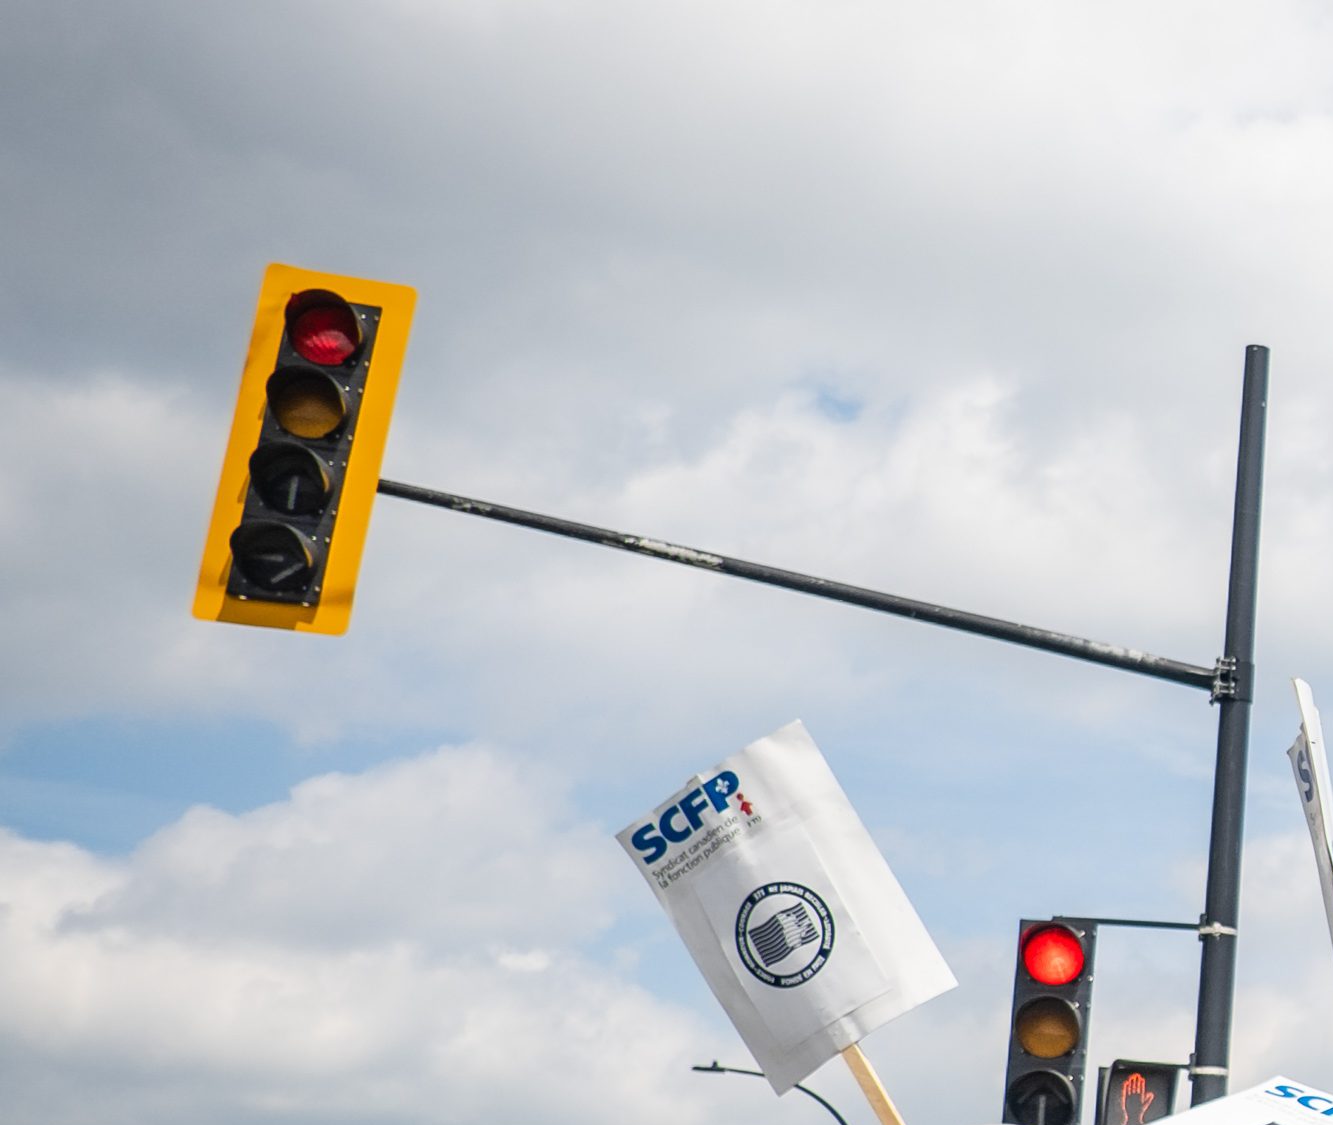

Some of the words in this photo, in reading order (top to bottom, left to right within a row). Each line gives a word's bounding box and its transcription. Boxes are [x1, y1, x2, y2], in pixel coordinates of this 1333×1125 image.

[631, 770, 739, 865] SCFP
[652, 851, 688, 881] Syndicat
[688, 824, 725, 855] canadien
[724, 816, 738, 828] de
[658, 880, 669, 890] la
[667, 855, 704, 883] fonction
[703, 828, 741, 859] publique
